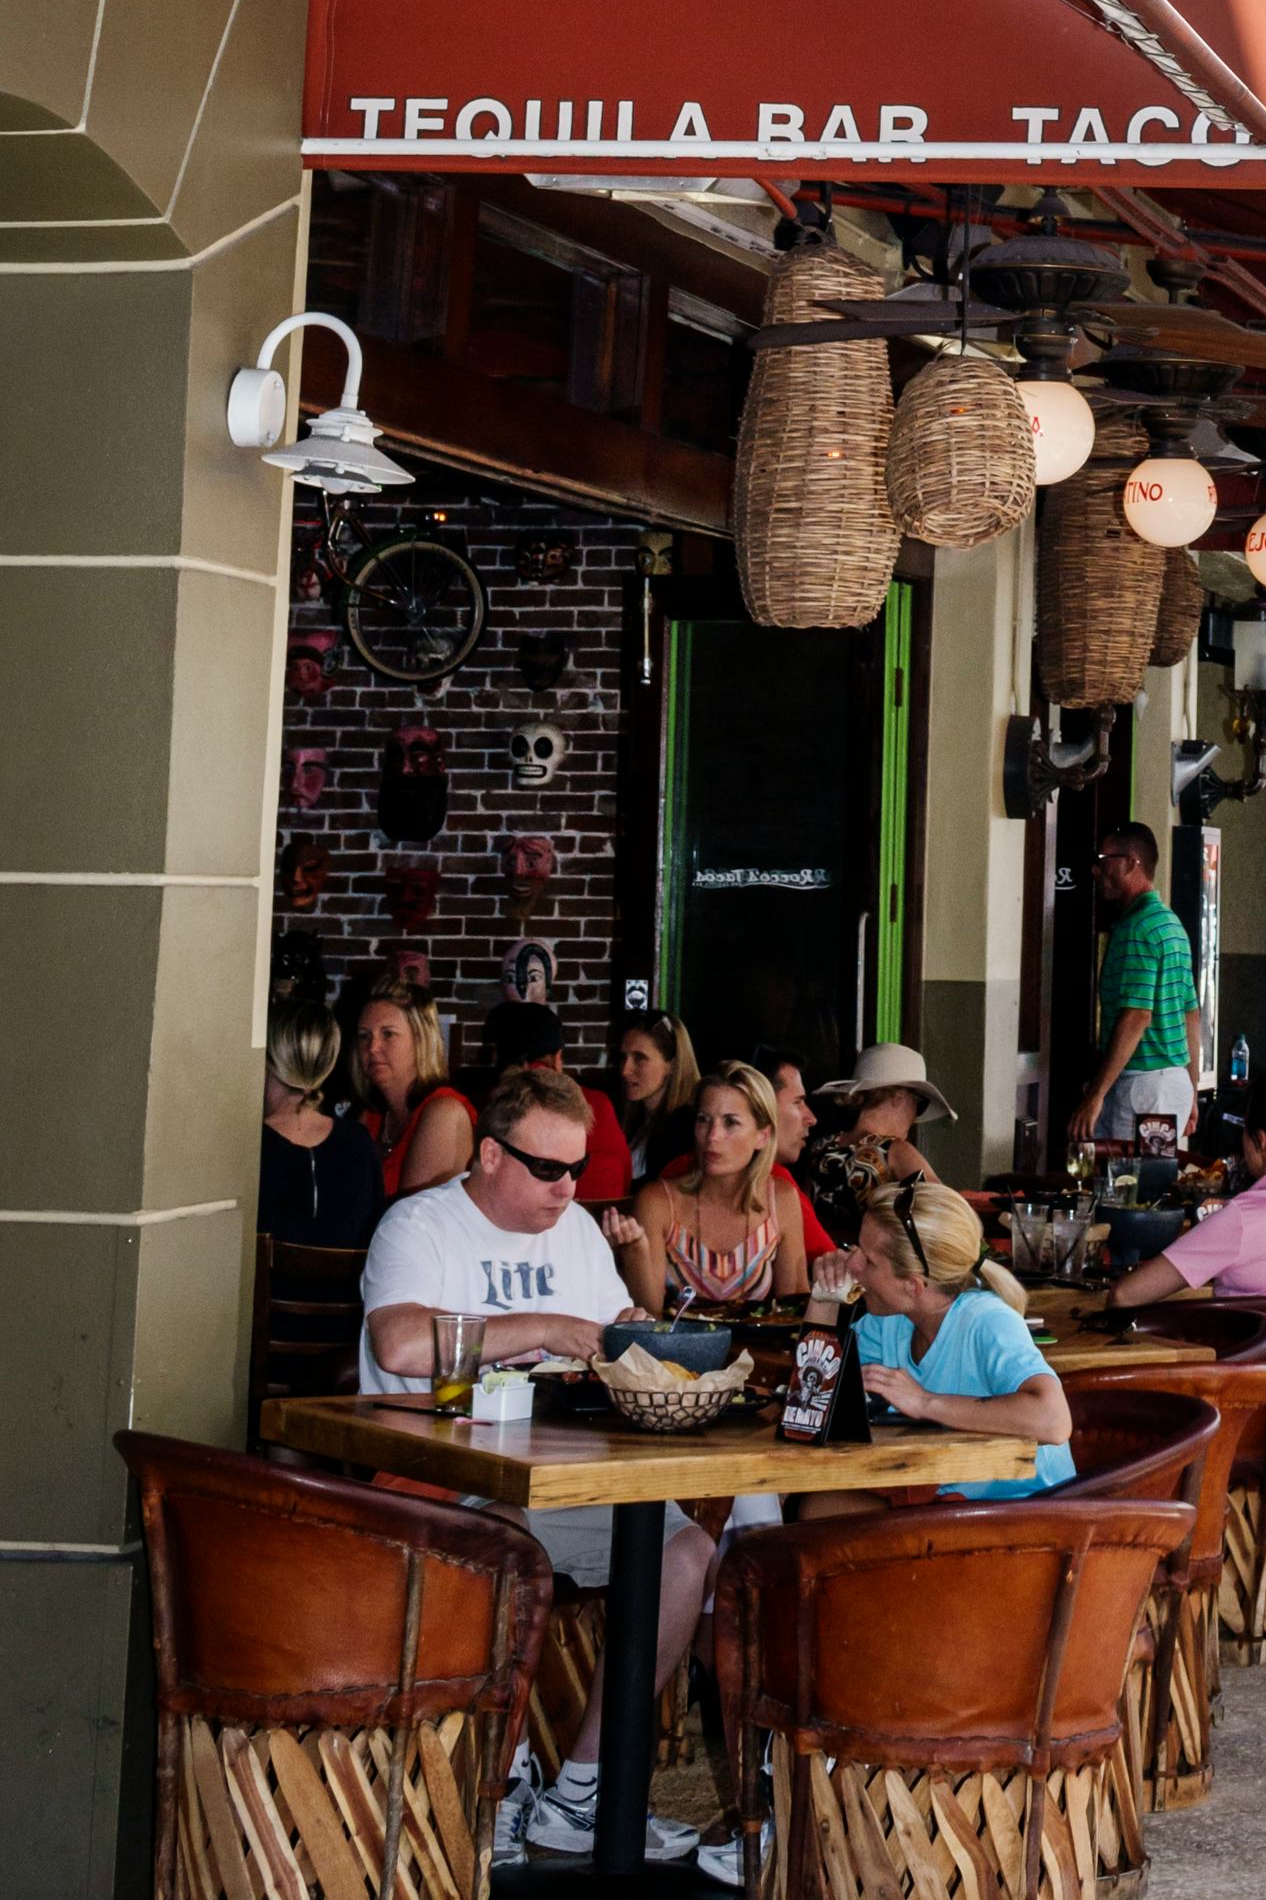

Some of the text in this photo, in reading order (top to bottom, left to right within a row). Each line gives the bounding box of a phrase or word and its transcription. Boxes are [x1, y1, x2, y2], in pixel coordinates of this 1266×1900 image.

[350, 97, 714, 159] TEQUILA
[757, 102, 929, 164] BAR
[480, 1260, 555, 1310] Lite
[796, 1339, 841, 1380] CINCO
